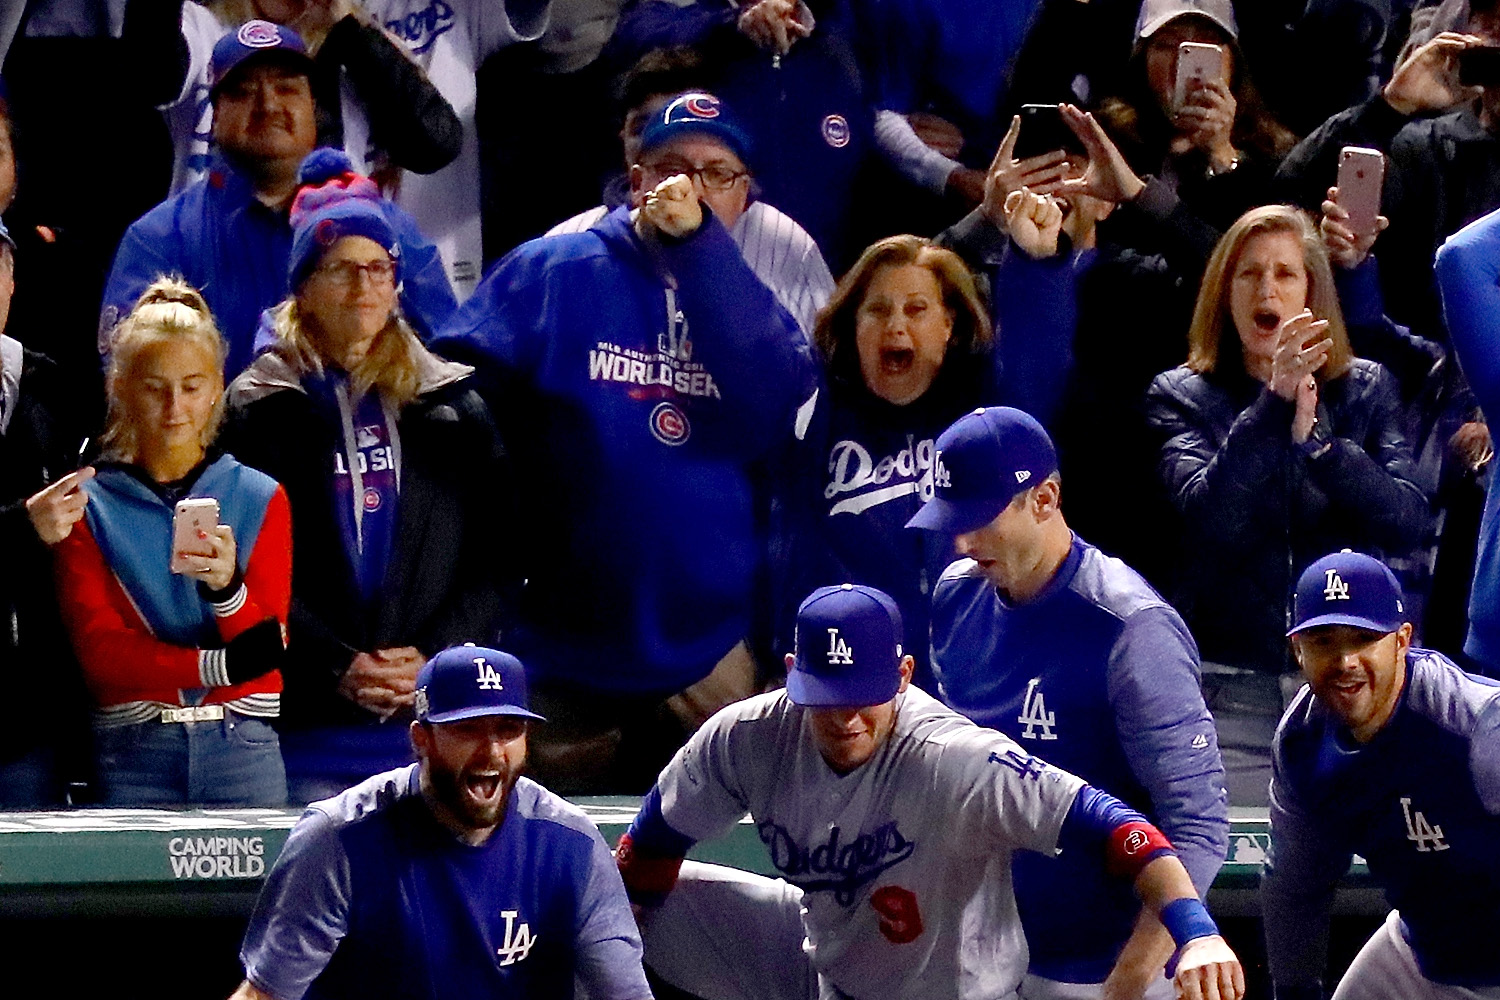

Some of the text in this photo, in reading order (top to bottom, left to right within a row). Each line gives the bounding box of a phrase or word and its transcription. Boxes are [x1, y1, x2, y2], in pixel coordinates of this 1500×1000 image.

[589, 349, 673, 387] WORLD
[1323, 569, 1350, 600] LA
[827, 628, 853, 664] LA
[473, 657, 503, 690] LA
[1018, 677, 1058, 740] LA
[1400, 797, 1450, 852] LA
[168, 836, 265, 856] CAMPING
[169, 855, 265, 878] WORLD
[870, 885, 923, 944] 9
[497, 910, 538, 966] LA
